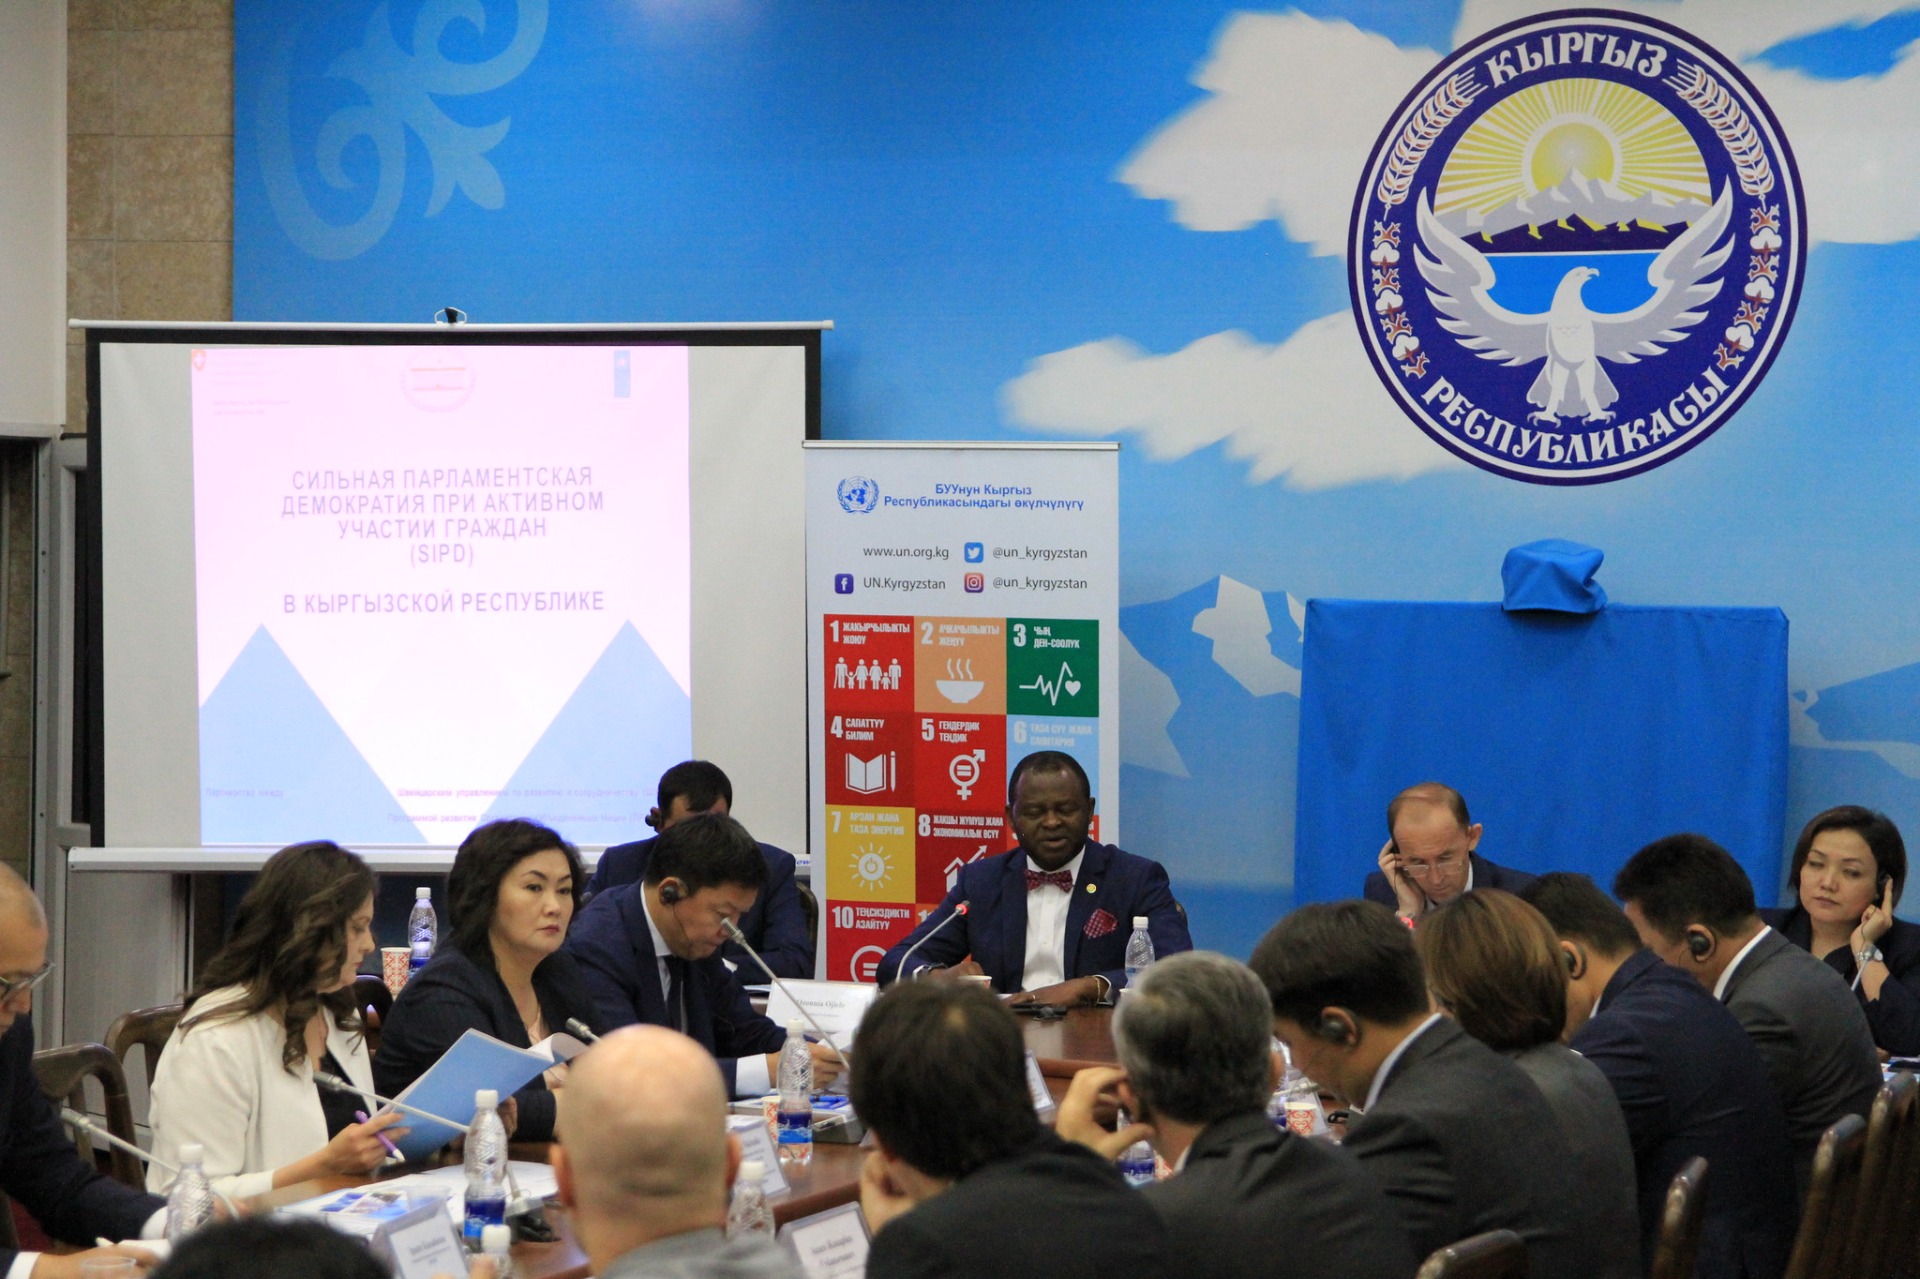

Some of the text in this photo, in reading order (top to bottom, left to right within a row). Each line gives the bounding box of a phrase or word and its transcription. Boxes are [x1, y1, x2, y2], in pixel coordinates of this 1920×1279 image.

[1484, 32, 1667, 87] КЫРГЫЗ
[1421, 367, 1732, 465] РЕСПУБЛИКАСЫ
[292, 467, 593, 491] СИЛЬНАЯ ПАРЛАМЕНТСКАЯ
[935, 483, 1032, 497] БУУнун Кыргыз
[282, 491, 604, 518] ДЕМОКРАТИЯ ПРИ АКТИВНОМ
[884, 496, 1011, 509] Республикасындагы
[338, 517, 546, 540] УЧАСТИИ ГРАЖДАН
[410, 543, 474, 567] (SIPD)
[863, 546, 949, 560] www.un.org.kg
[992, 547, 1088, 561] @un_kyrgyzstan
[863, 577, 946, 592] UN.Kyrgyzstan
[992, 577, 1088, 592] @un_kyrgyzstan
[284, 589, 604, 614] В КЫРГЫЗСКОЙ РЕСПУБЛИКЕ
[830, 620, 839, 642] 1
[921, 622, 933, 644] 2
[1013, 623, 1026, 647] 3
[831, 716, 843, 738] 4
[846, 731, 874, 741] БИЛИМ
[921, 718, 935, 741] 5
[1014, 720, 1026, 744] 6
[831, 811, 841, 833] 7
[918, 814, 931, 837] 8
[832, 906, 854, 929] 10
